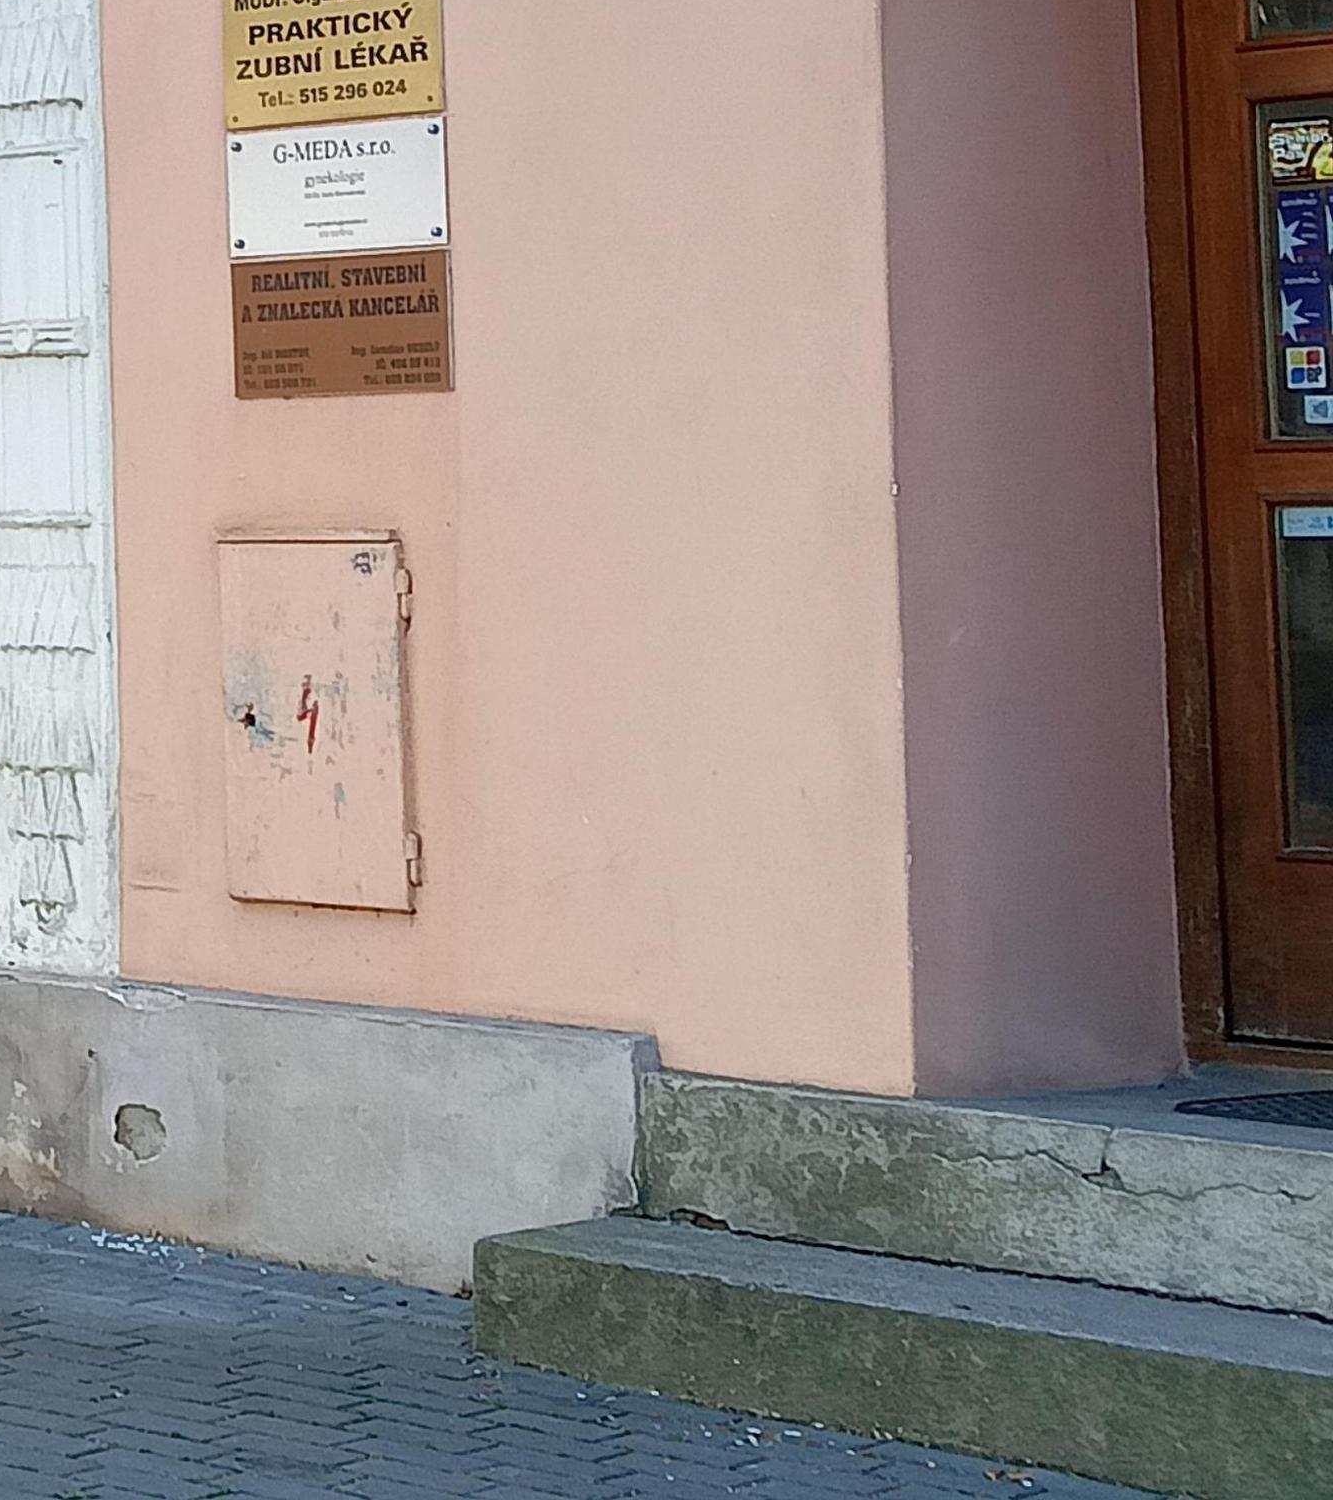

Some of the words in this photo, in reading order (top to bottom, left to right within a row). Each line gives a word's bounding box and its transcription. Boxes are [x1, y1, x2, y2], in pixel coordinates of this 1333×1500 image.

[248, 1, 413, 46] PRAKTICKÝ
[236, 46, 323, 81] ZUBNÍ
[334, 35, 429, 70] LÉKAŘ
[299, 86, 328, 104] 515
[334, 83, 367, 101] 296
[372, 79, 408, 96] 024
[273, 139, 353, 164] G-MEDA
[356, 139, 396, 158] s.r.o.
[304, 169, 365, 189] gynekologie
[341, 257, 427, 288] STAVEBNÍ
[241, 304, 252, 323] A
[257, 294, 343, 322] ZNALECKÁ
[349, 288, 440, 317] KANCELÁŘ
